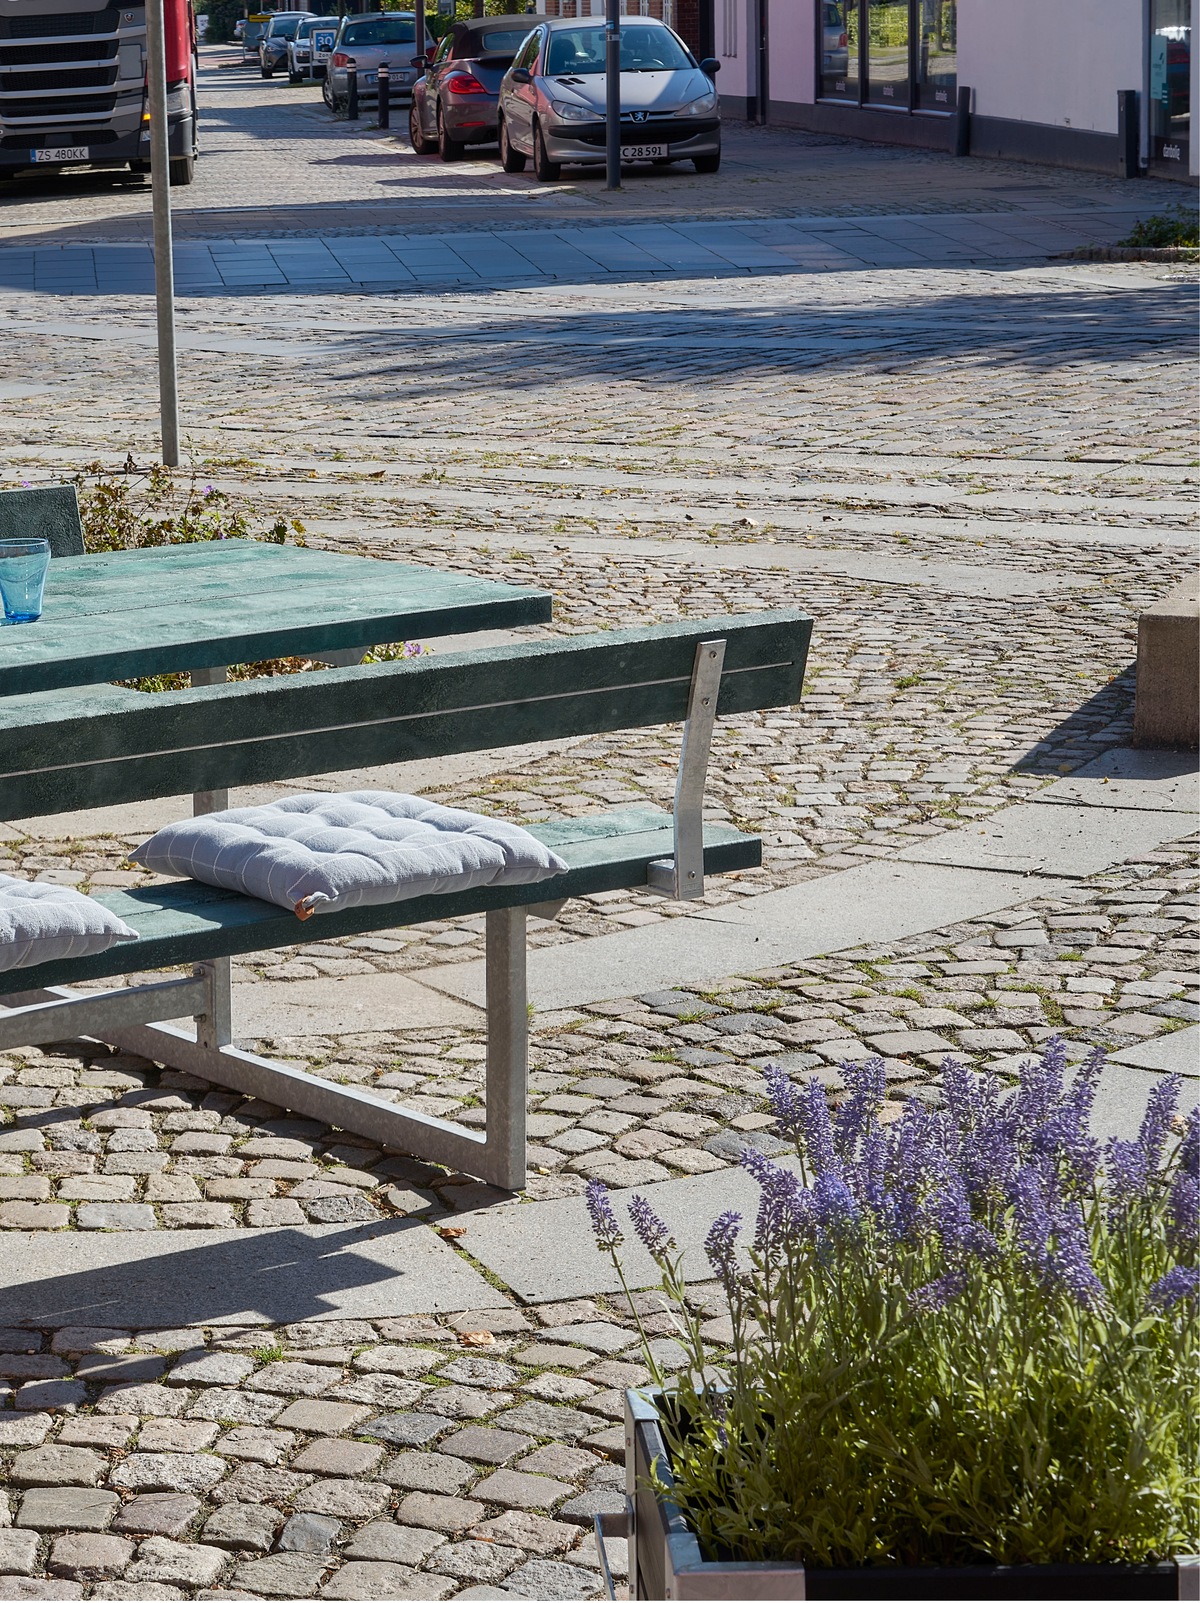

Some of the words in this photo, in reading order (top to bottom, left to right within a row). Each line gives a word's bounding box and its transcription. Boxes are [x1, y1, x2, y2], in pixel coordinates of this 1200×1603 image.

[318, 36, 332, 46] 30
[37, 150, 52, 161] ZS
[54, 147, 86, 160] 480KK
[631, 147, 643, 157] 28
[645, 146, 662, 156] 591
